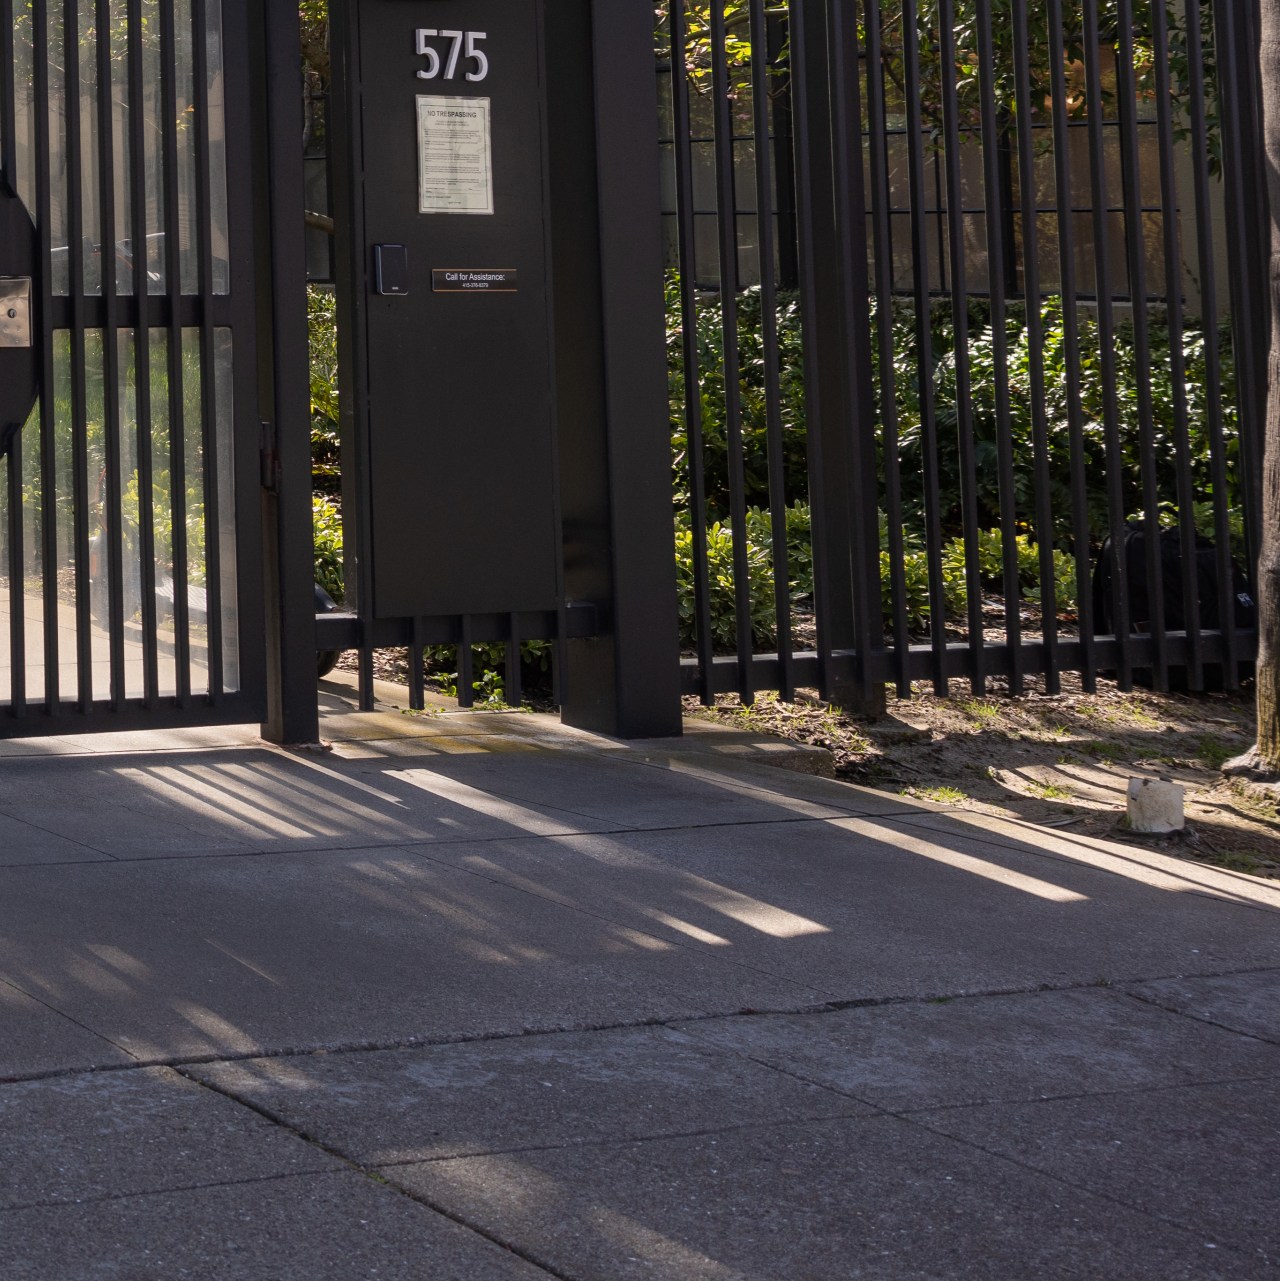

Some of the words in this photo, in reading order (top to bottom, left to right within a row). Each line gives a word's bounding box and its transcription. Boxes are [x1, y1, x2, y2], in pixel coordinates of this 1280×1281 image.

[415, 28, 488, 82] 575
[436, 110, 477, 118] TRESPASSING
[445, 272, 458, 281] Call
[459, 272, 468, 281] for
[469, 272, 506, 281] Assistance:
